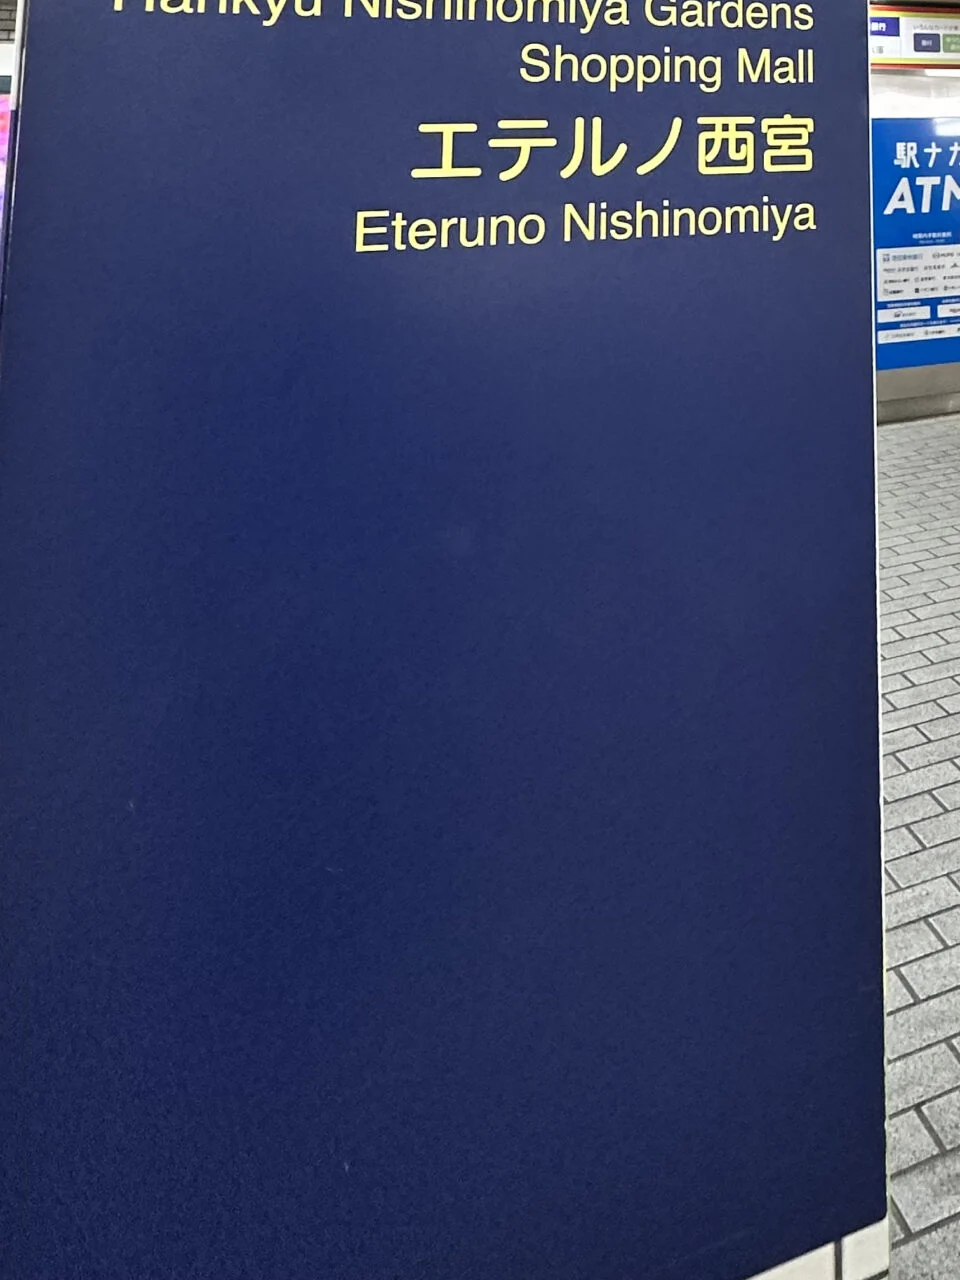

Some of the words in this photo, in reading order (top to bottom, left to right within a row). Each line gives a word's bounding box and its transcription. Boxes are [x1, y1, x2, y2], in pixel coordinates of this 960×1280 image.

[519, 43, 722, 93] Shopping
[738, 47, 814, 84] Mall
[410, 113, 815, 182] エテルノ西宮
[354, 209, 546, 253] Eteruno
[563, 194, 817, 242] Nishinomiya
